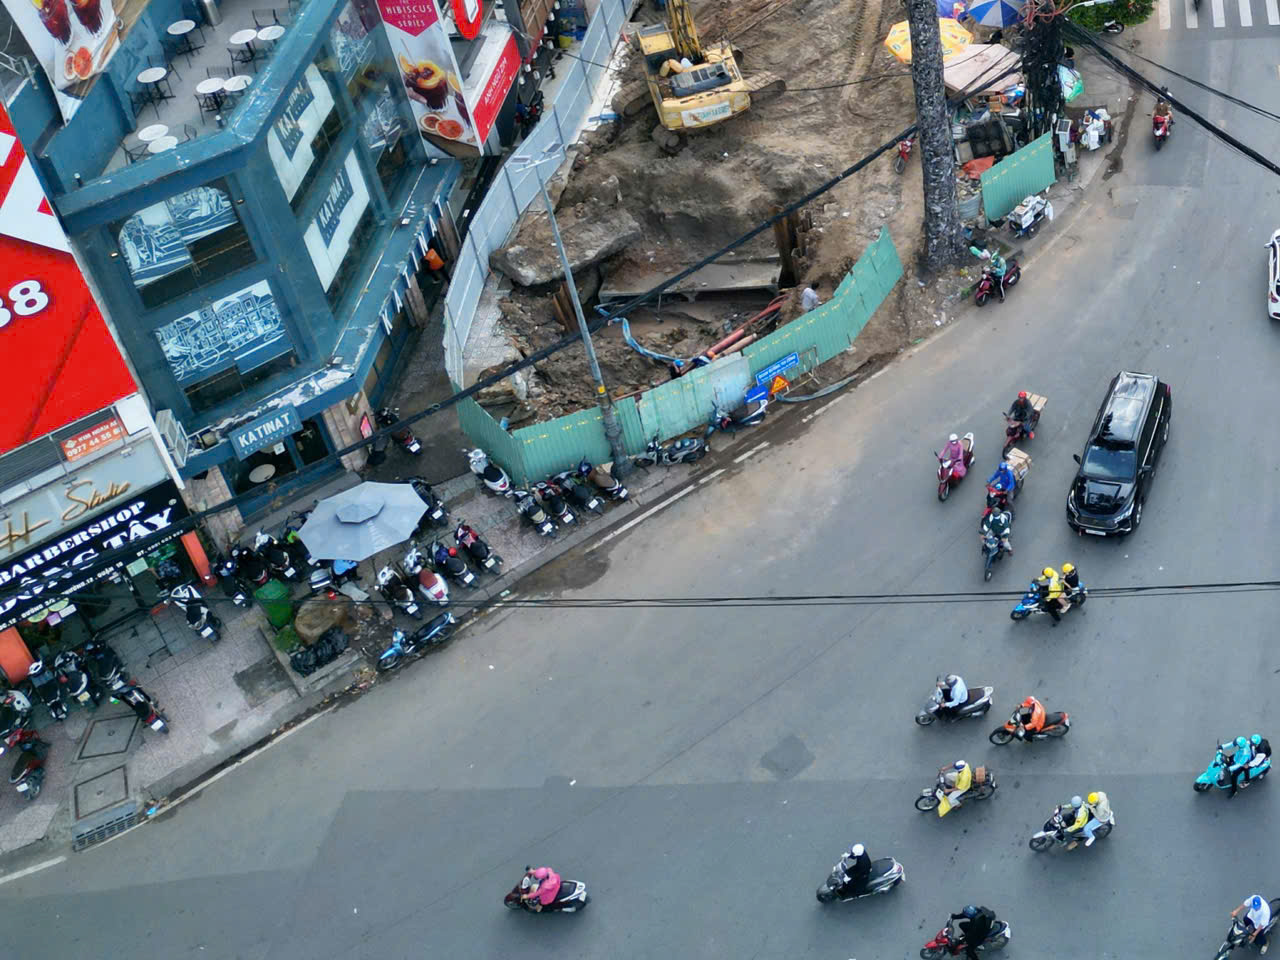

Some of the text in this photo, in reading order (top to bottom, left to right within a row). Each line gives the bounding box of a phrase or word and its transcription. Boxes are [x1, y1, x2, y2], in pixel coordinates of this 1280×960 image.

[385, 5, 433, 15] HIBISCUS
[239, 412, 291, 448] KATINAT
[103, 507, 172, 550] TÂY
